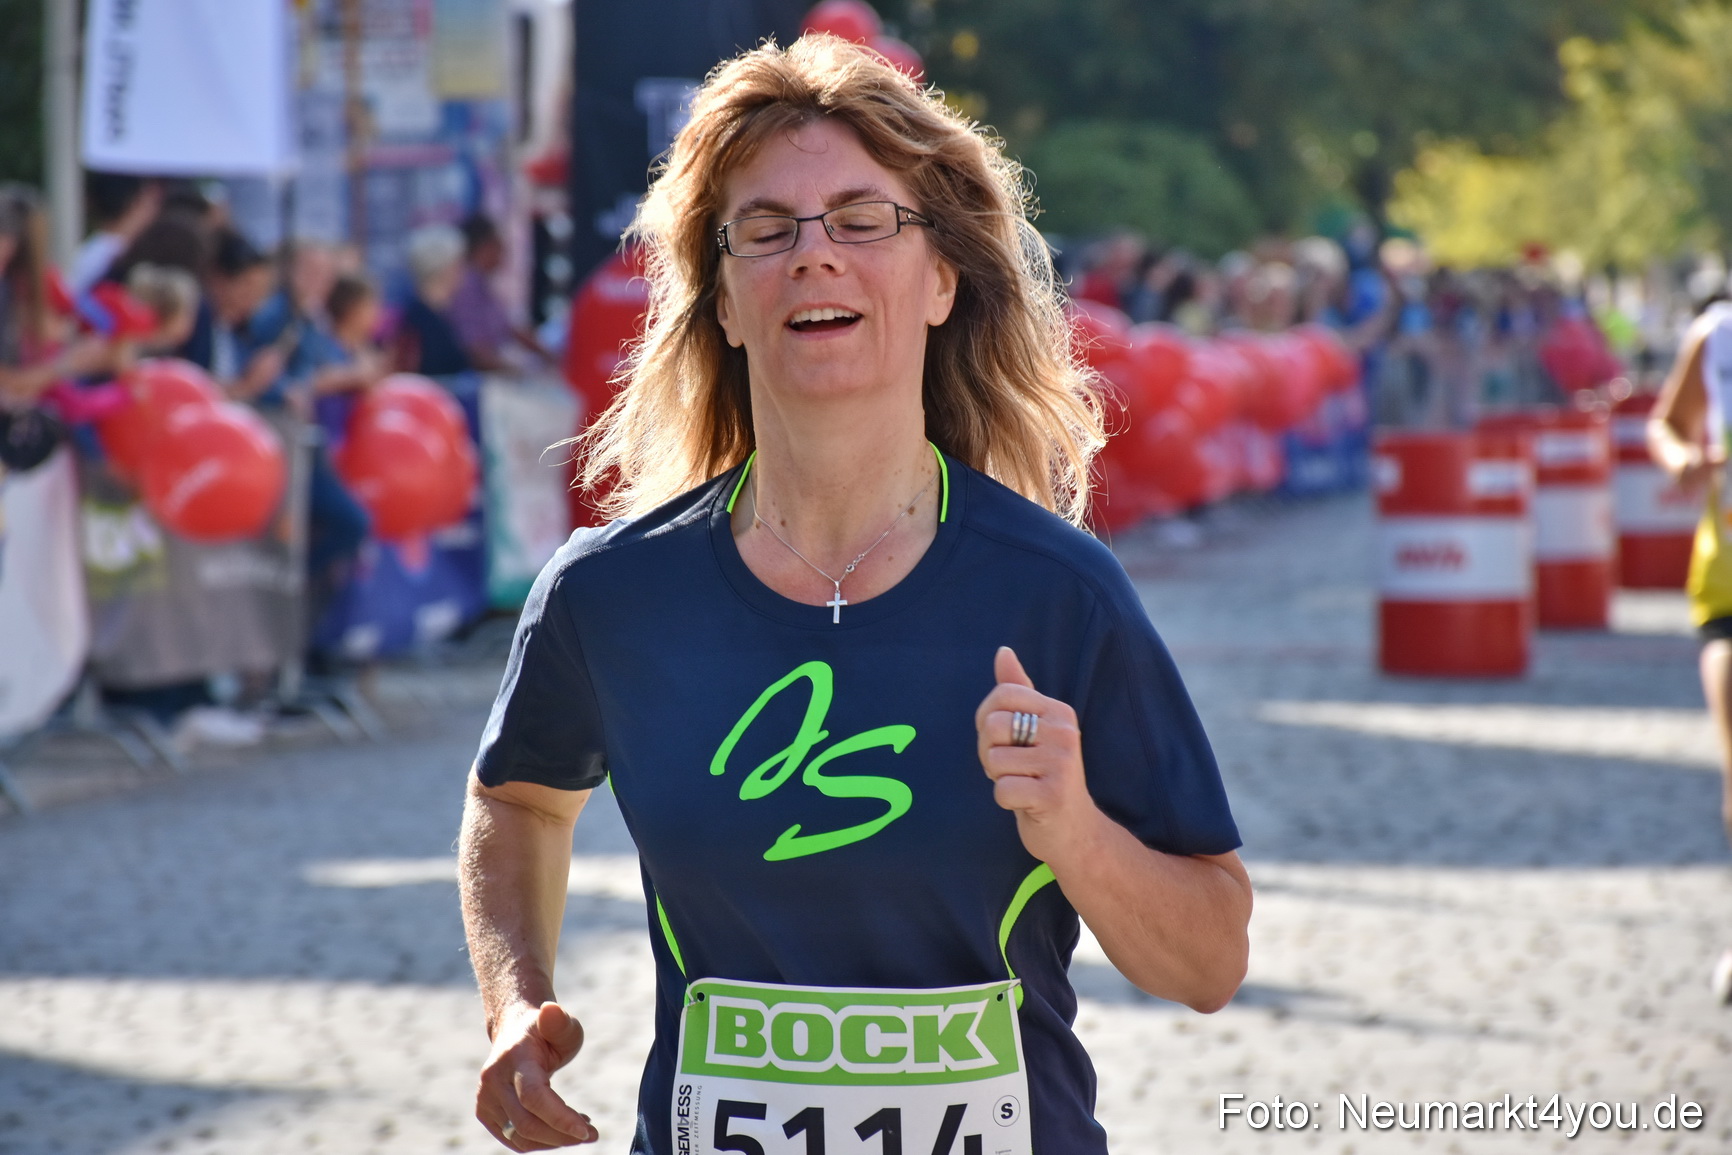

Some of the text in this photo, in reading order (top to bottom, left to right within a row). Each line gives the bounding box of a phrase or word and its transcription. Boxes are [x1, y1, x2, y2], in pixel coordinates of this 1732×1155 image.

[709, 998, 994, 1071] BOCK
[693, 1085, 703, 1139] ZEITMESSUNG
[1000, 1102, 1014, 1120] S
